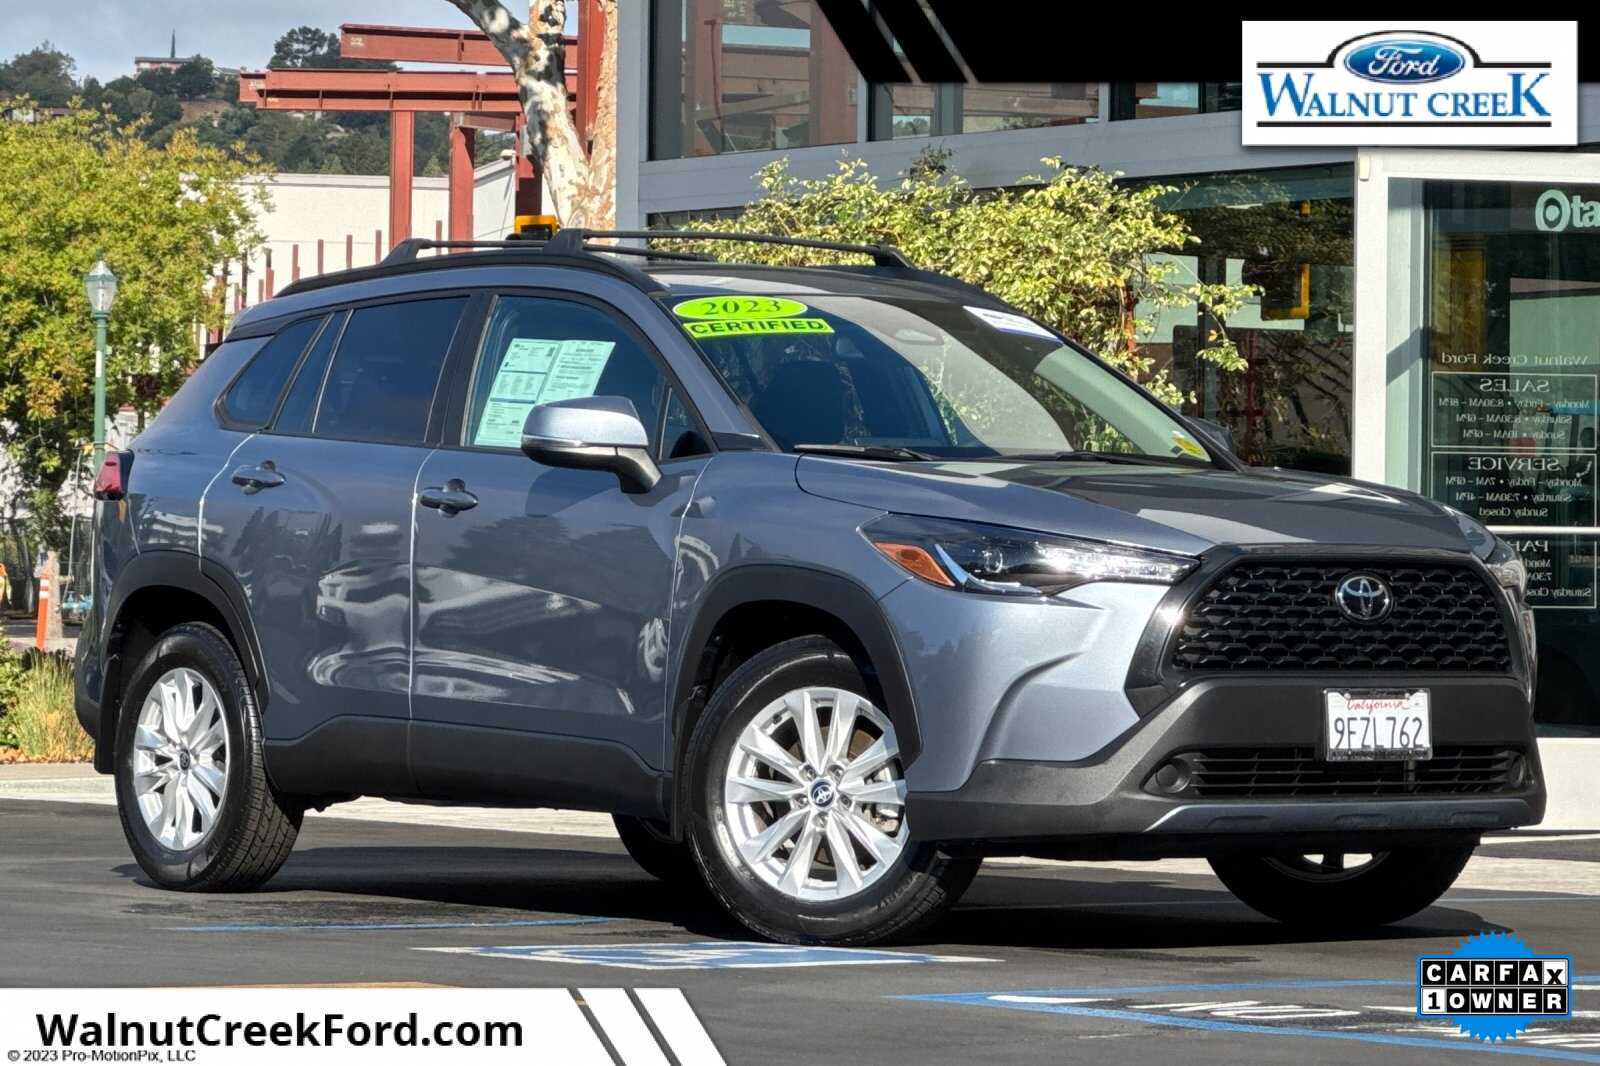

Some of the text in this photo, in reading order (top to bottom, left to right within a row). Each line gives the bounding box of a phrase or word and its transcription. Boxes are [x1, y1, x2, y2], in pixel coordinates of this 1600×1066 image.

[702, 300, 781, 315] 2023
[690, 319, 824, 334] CERTIFIED
[1334, 716, 1425, 749] 9FZL762
